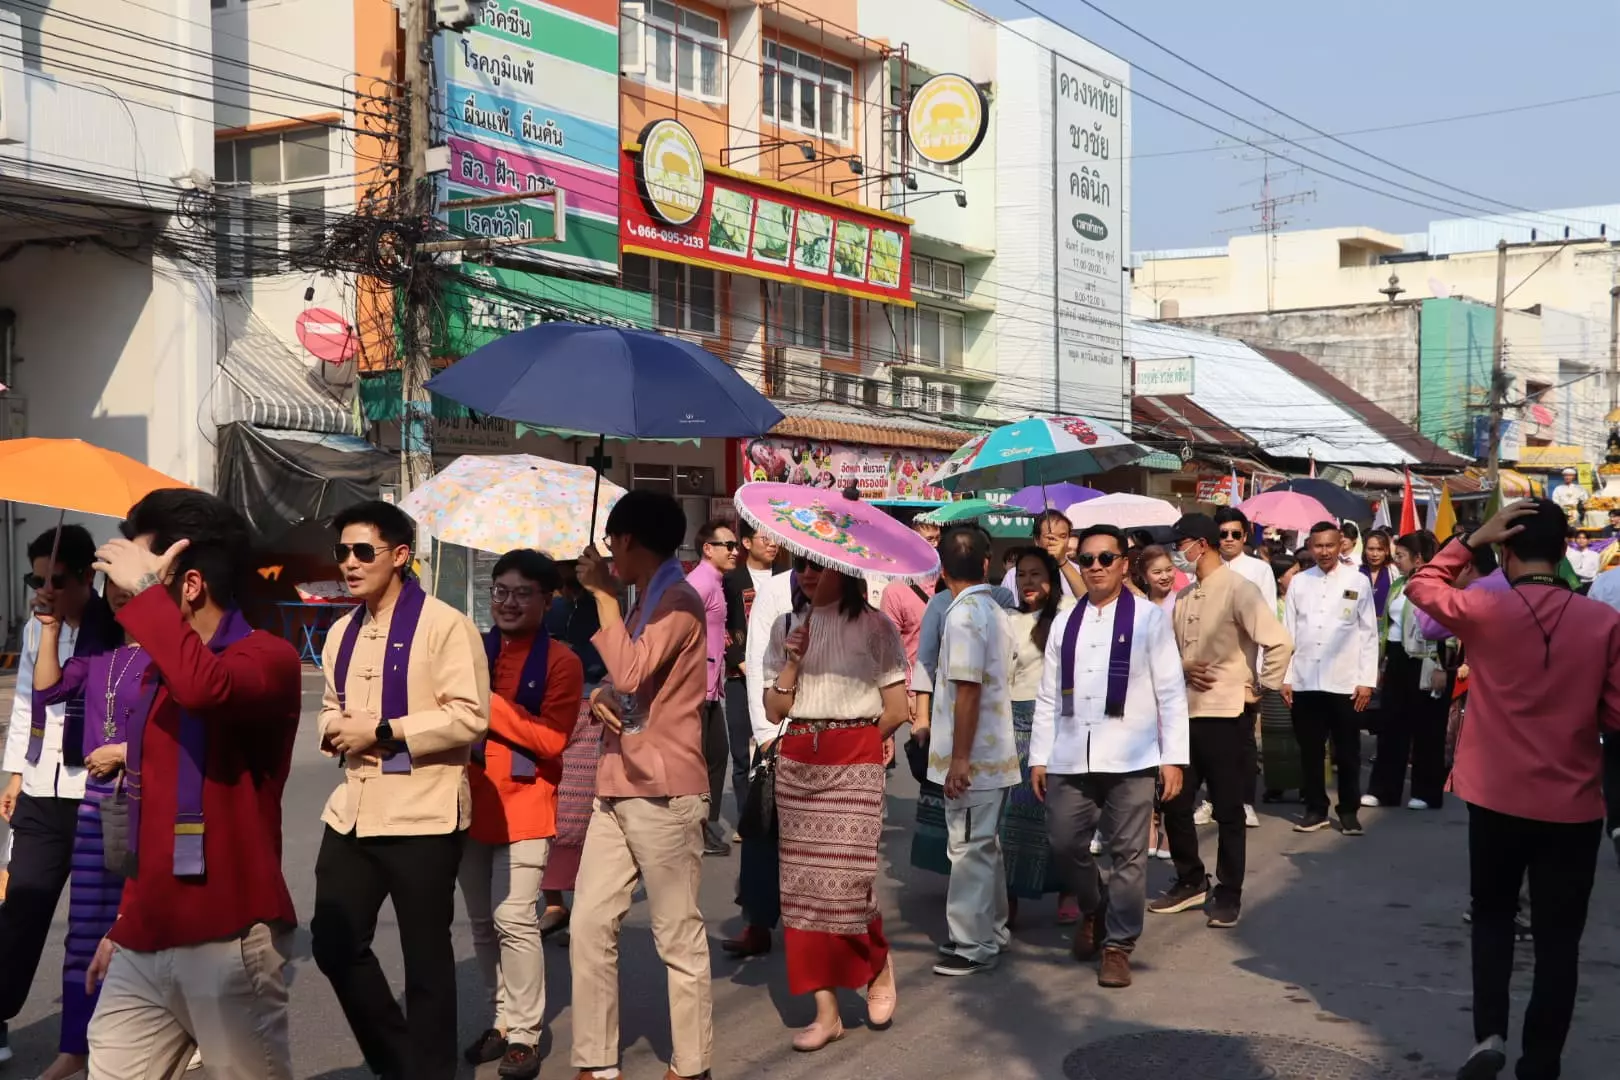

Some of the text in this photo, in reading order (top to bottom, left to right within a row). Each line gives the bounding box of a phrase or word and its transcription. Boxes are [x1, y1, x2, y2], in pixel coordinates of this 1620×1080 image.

[461, 38, 534, 86] โรคภูมิแพ้
[1060, 72, 1118, 118] ดวงหทัย
[522, 108, 564, 147] ผื่นคัน
[1069, 121, 1109, 160] ชวชัย
[1070, 165, 1110, 207] คลินิก
[637, 224, 704, 249] 066-095-2133
